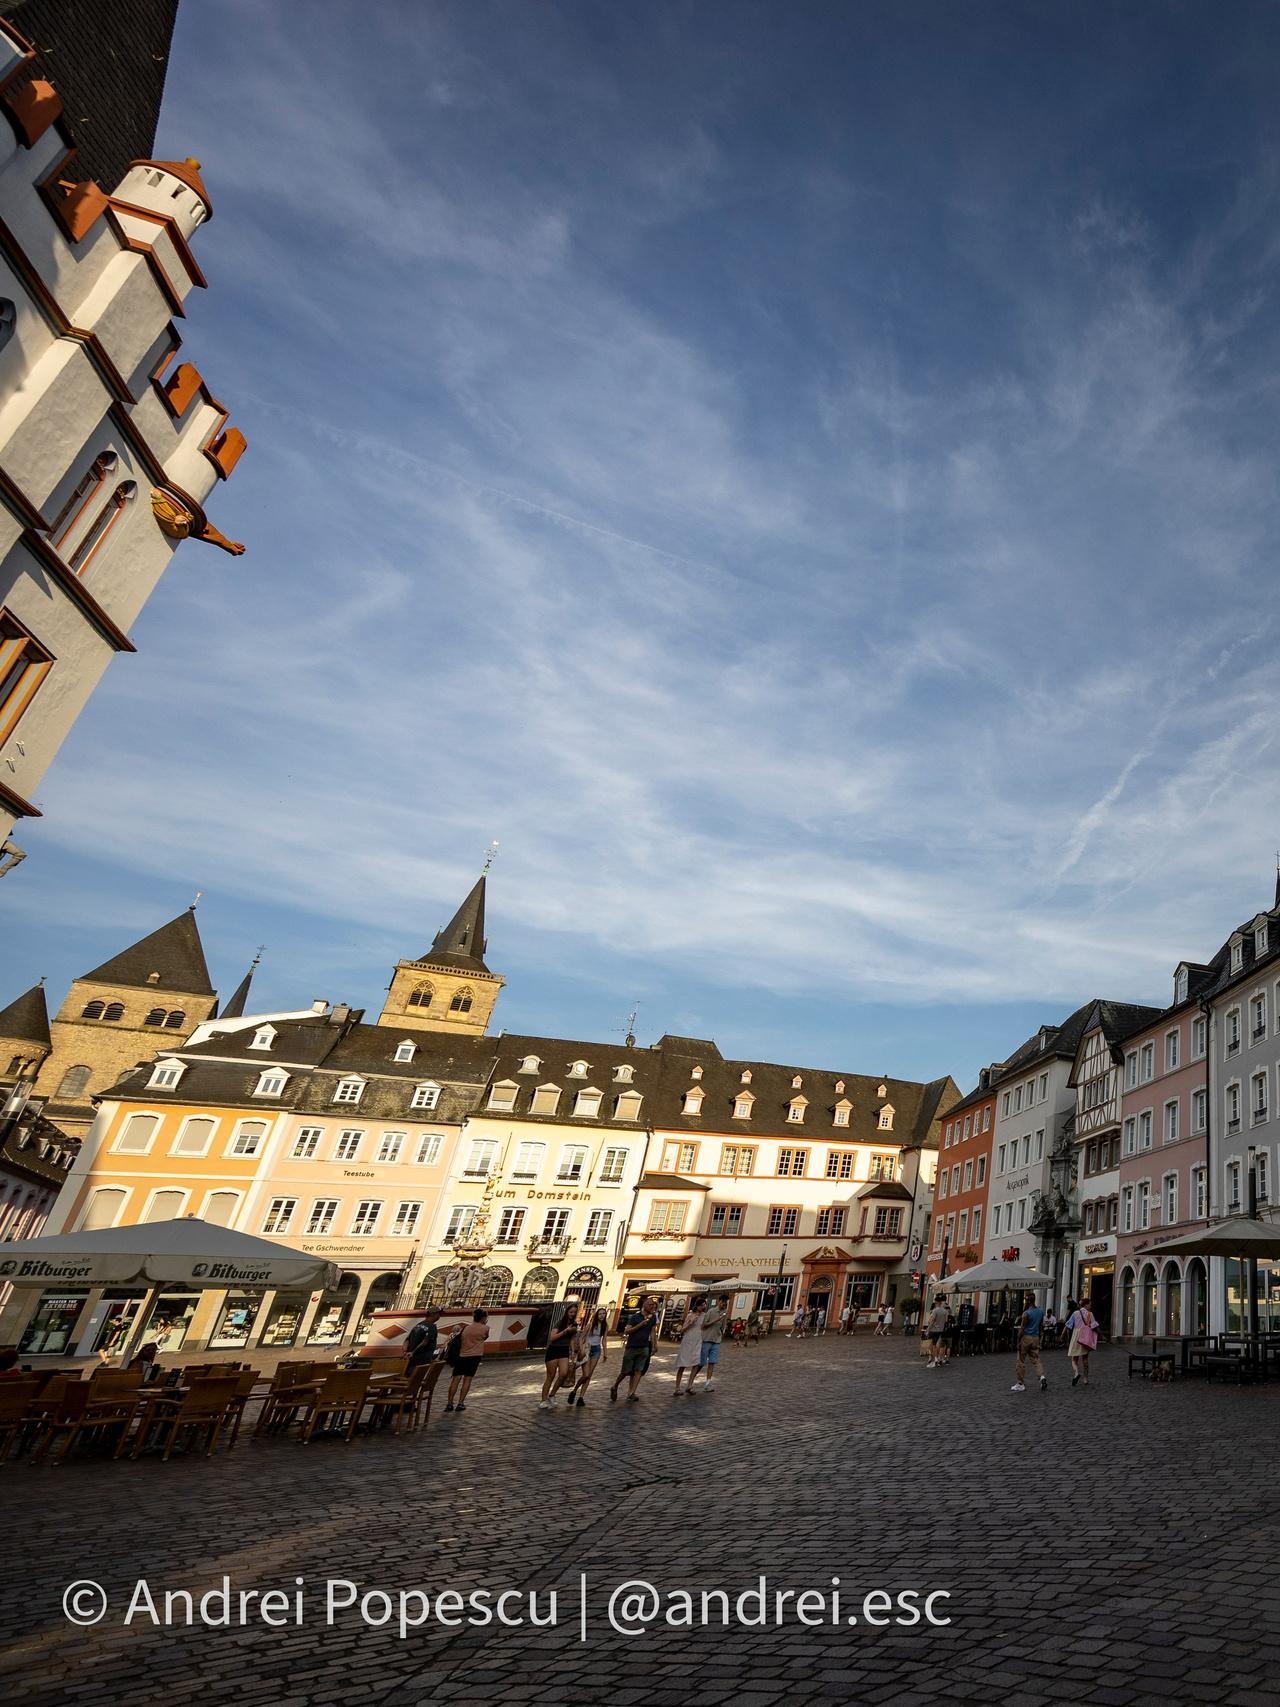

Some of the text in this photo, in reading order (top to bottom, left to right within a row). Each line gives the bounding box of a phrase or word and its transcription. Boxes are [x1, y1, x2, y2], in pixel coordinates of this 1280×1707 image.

[343, 1170, 375, 1178] Teestube
[494, 1189, 592, 1201] um Domstein
[302, 1244, 365, 1252] Tee Gschwendner
[16, 1260, 93, 1279] Bitburger
[207, 1263, 272, 1282] Bitburger
